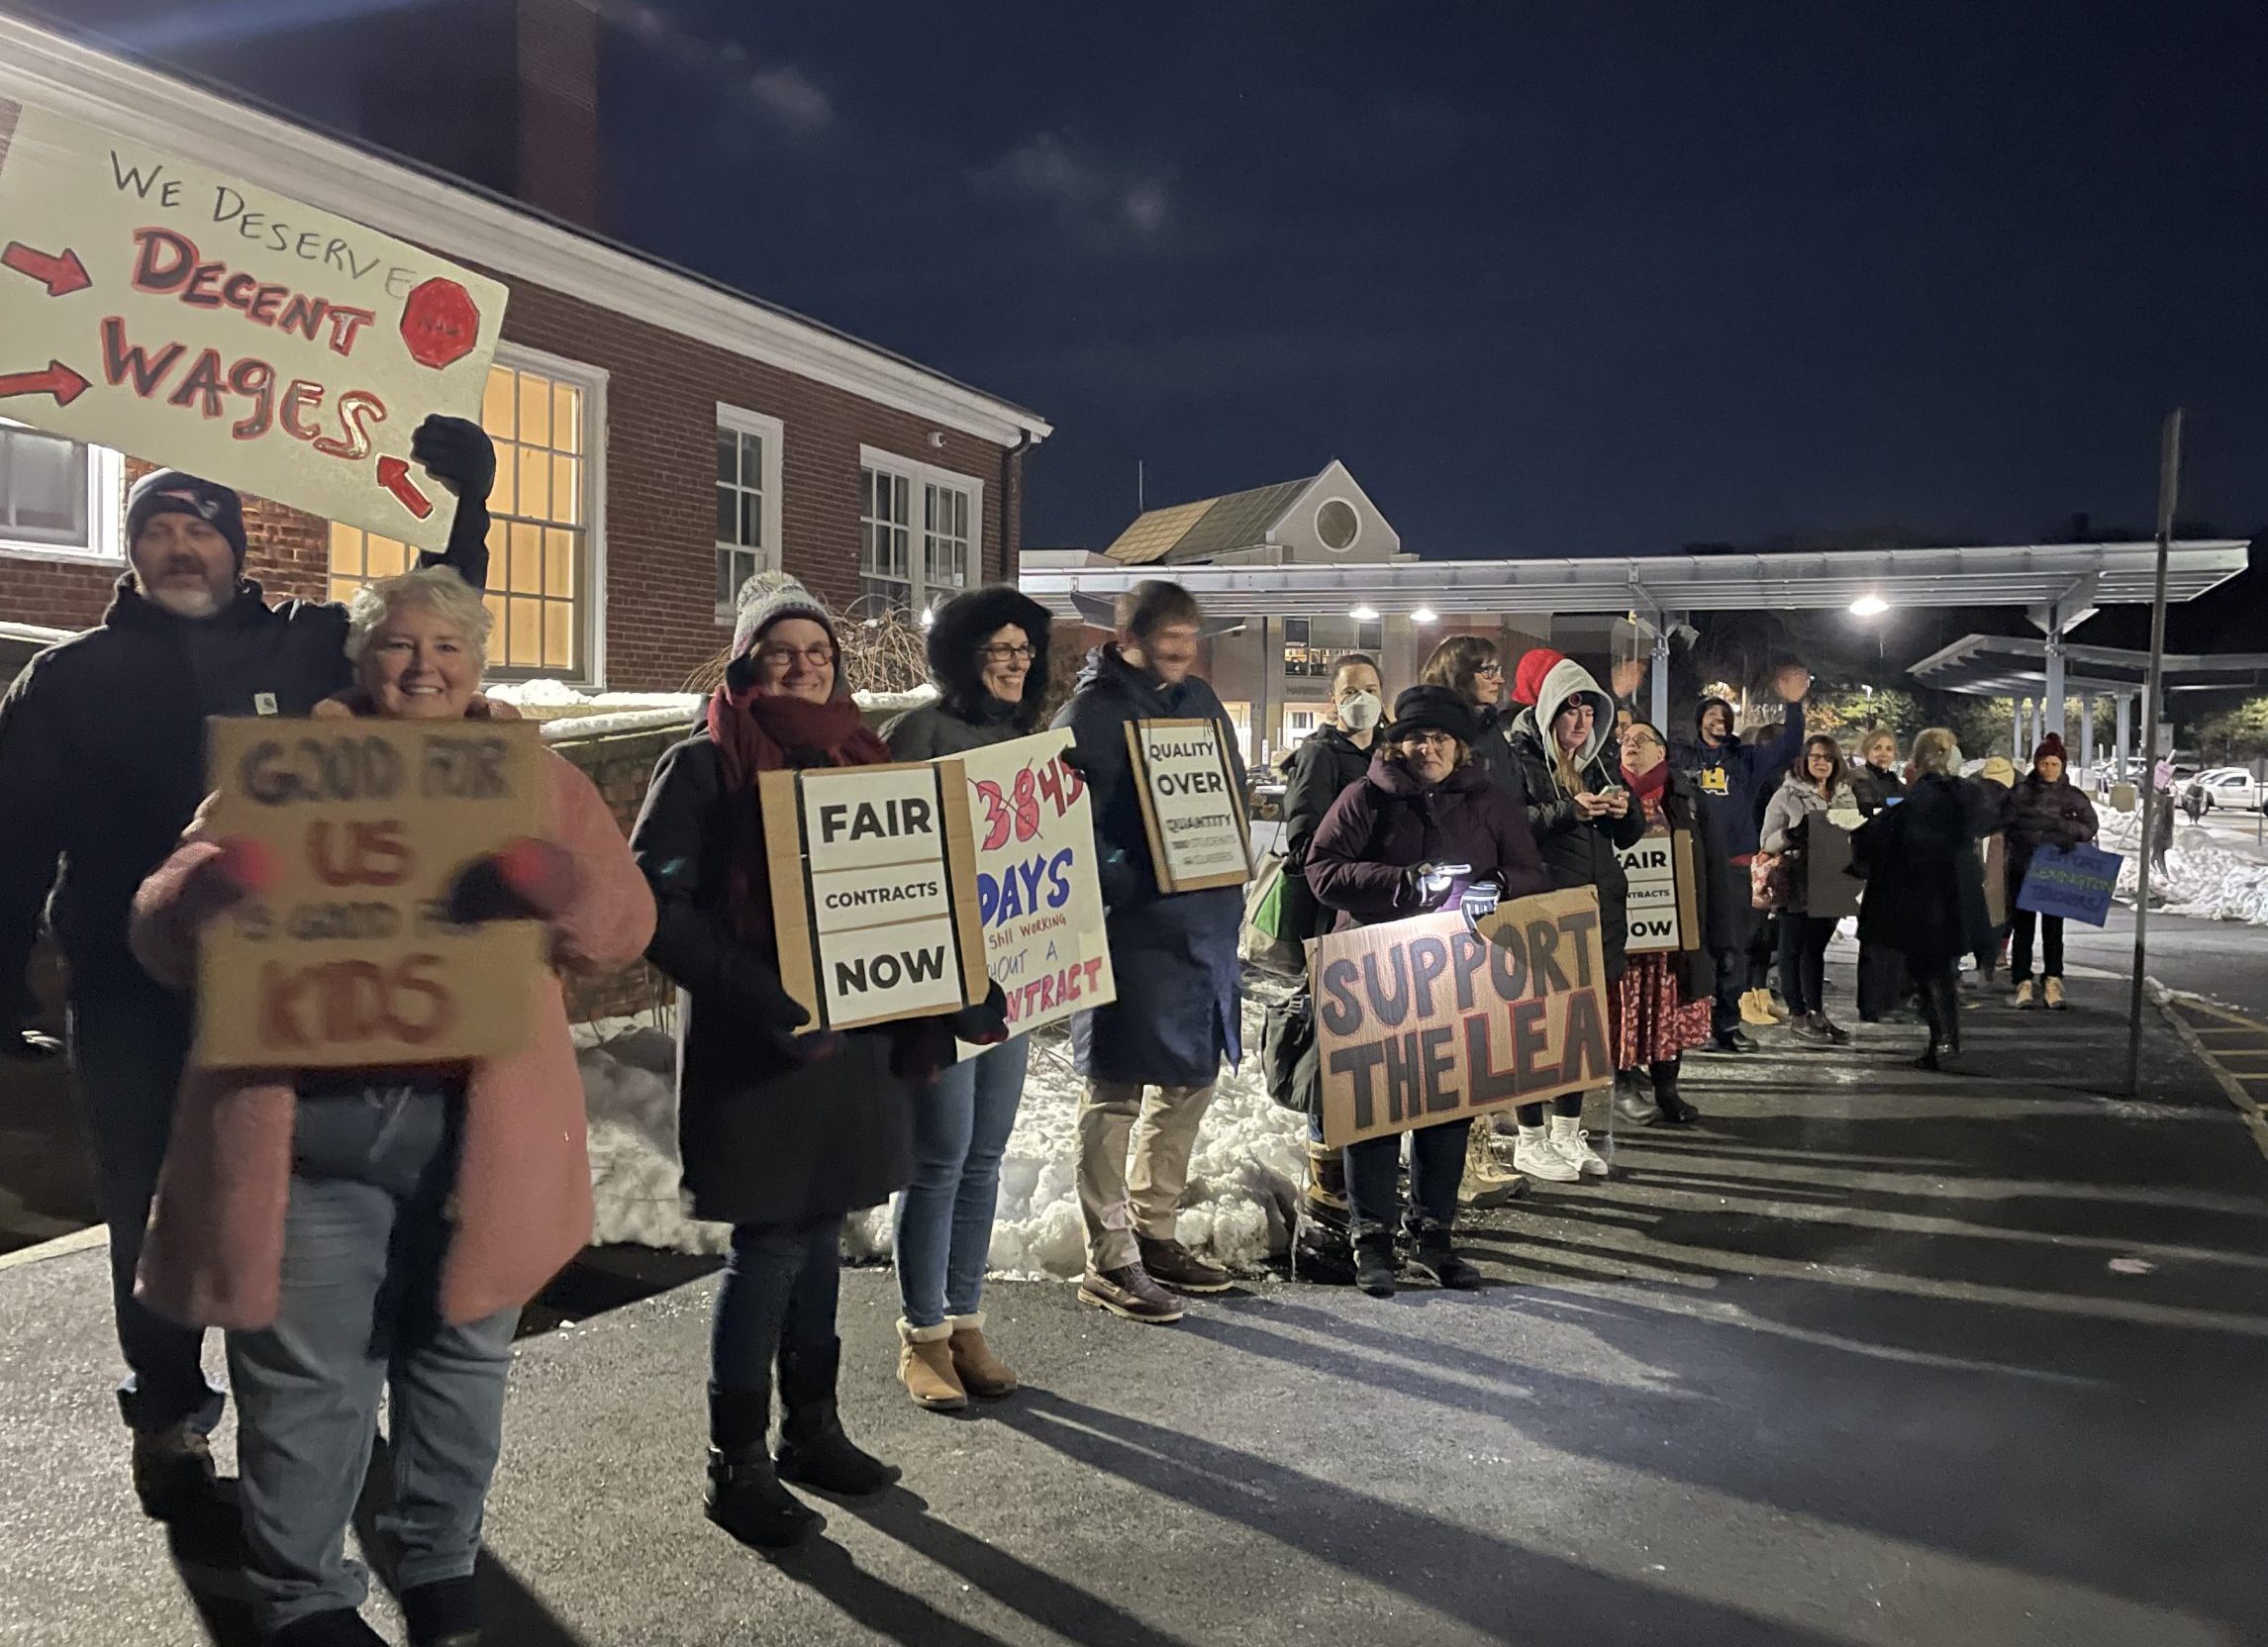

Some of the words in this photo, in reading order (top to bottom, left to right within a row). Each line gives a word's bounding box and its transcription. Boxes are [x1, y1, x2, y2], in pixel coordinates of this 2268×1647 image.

[110, 149, 181, 208] WE
[213, 185, 417, 299] DESERVE
[132, 226, 376, 356] DECENT
[1149, 741, 1214, 761] QUALITY
[1157, 771, 1224, 796] OVER
[820, 798, 933, 842] FAIR
[1166, 814, 1232, 832] QUANTITY
[305, 820, 416, 887] US
[825, 882, 937, 909] CONTRACTS
[977, 847, 1073, 927] DAYS
[1020, 914, 1067, 938] WORKING
[1630, 920, 1672, 937] OW
[835, 945, 944, 996] NOW
[987, 948, 1028, 983] HOUT
[1045, 939, 1058, 961] A
[1321, 910, 1597, 1035] SUPPORT
[1006, 956, 1103, 1023] NTRACT
[1330, 1025, 1460, 1129] THE
[1463, 987, 1611, 1107] LEA
